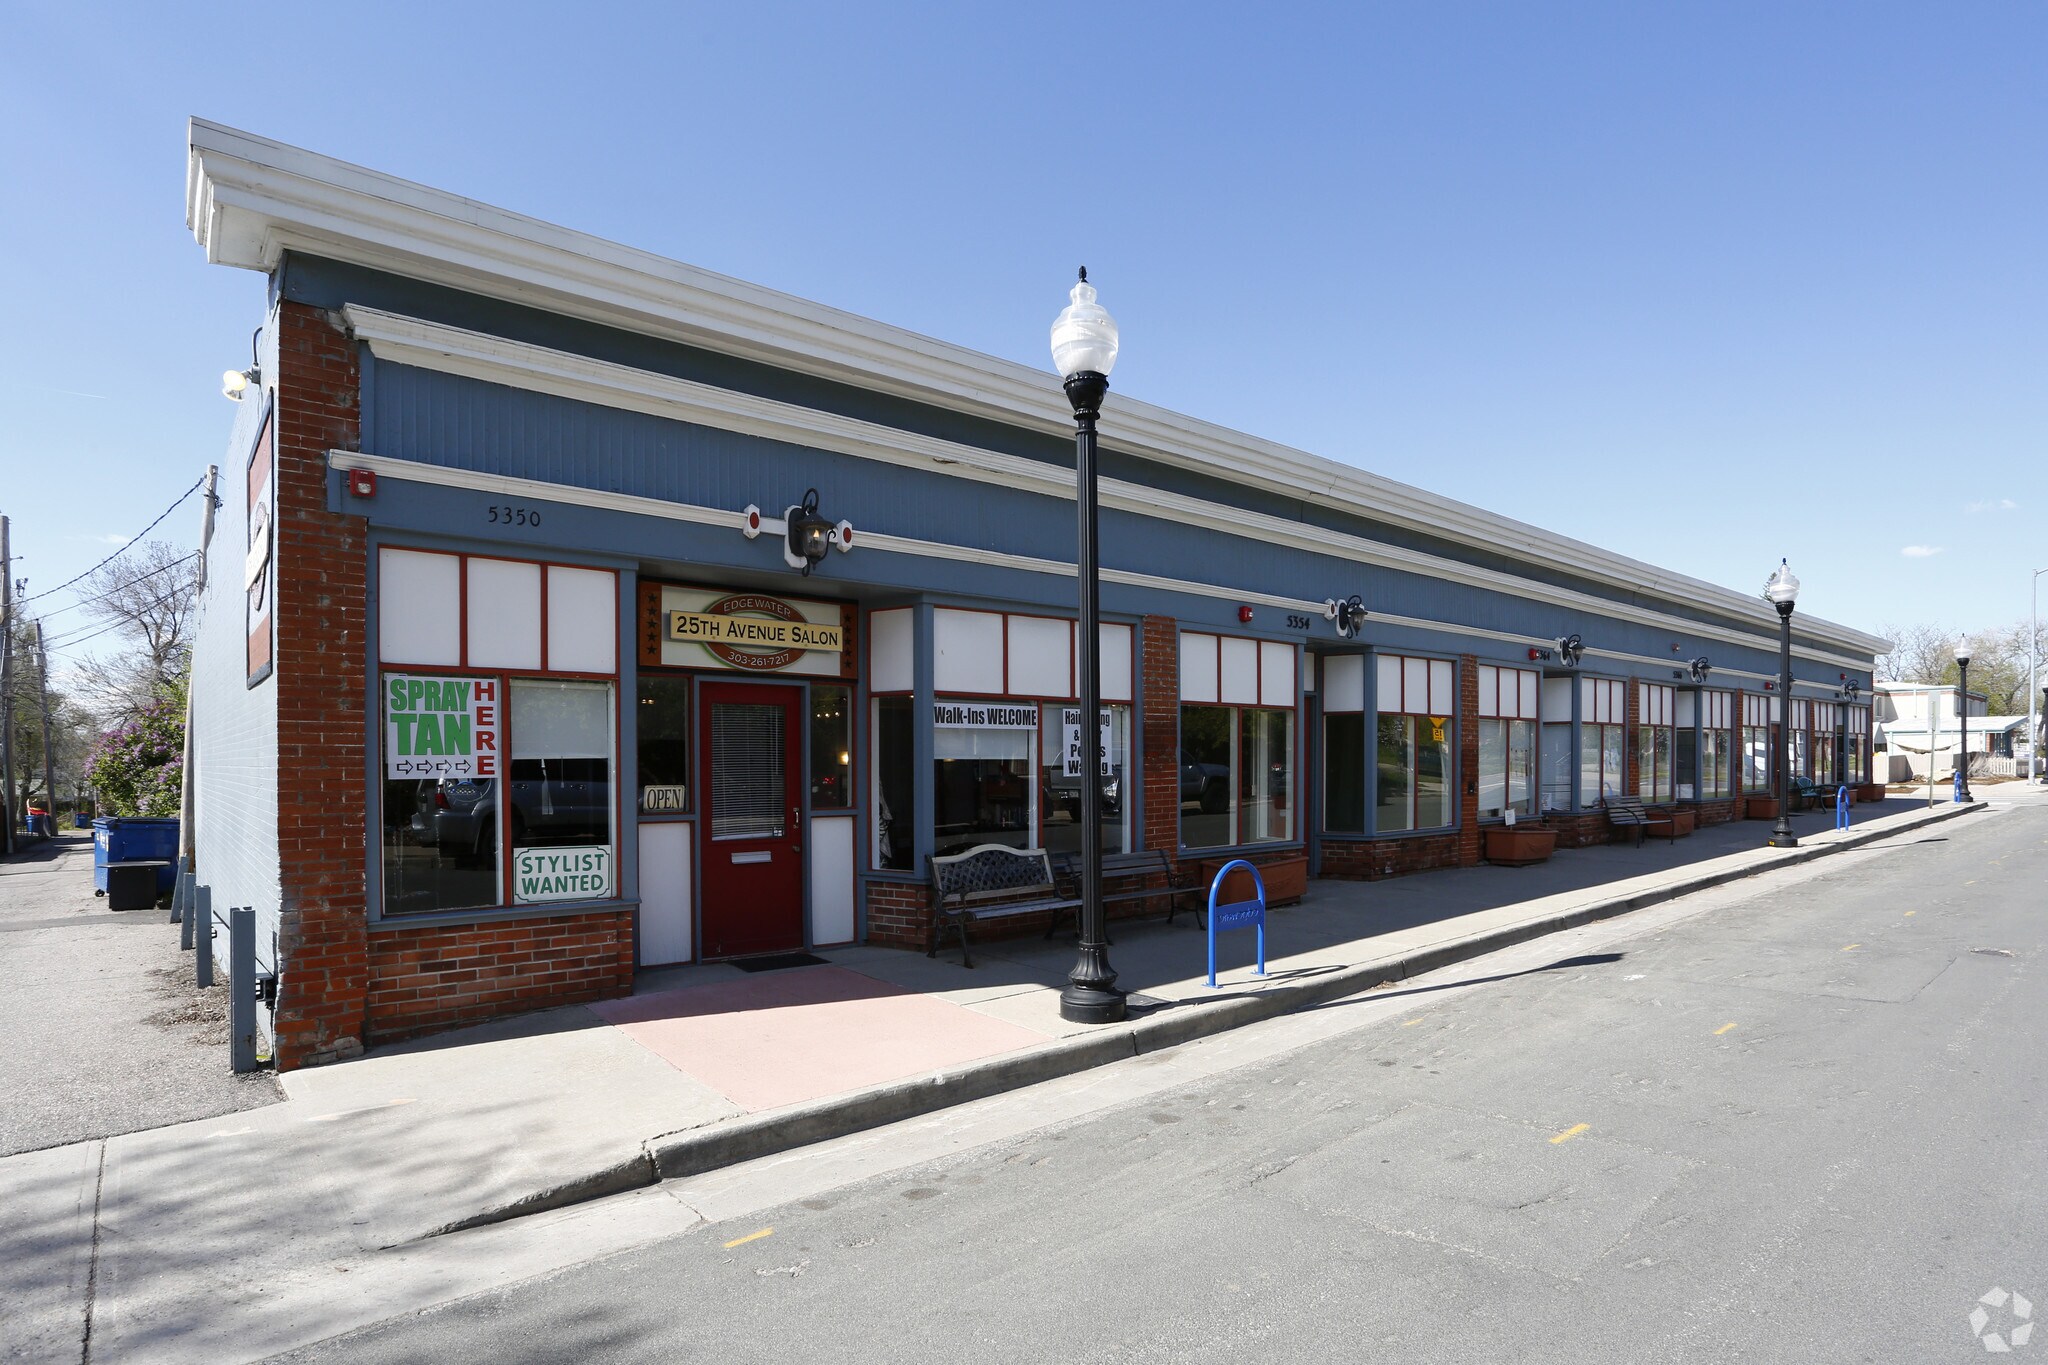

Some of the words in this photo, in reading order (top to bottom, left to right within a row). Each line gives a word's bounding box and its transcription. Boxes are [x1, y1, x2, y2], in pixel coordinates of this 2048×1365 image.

[488, 506, 541, 528] 5350
[723, 598, 791, 618] EDGEWATER
[676, 615, 720, 637] 25TH
[726, 620, 786, 642] AVENUE
[791, 626, 838, 646] SALON
[1286, 615, 1310, 630] 5354
[727, 652, 790, 666] 303-261-7217
[390, 678, 472, 712] SPRAY
[934, 706, 985, 725] Walk-Ins
[986, 708, 1037, 726] WELCOME
[390, 713, 471, 756] TAN
[474, 681, 497, 776] HERE
[646, 788, 682, 810] OPEN
[521, 853, 604, 875] STYLIST
[521, 874, 604, 896] WANTED
